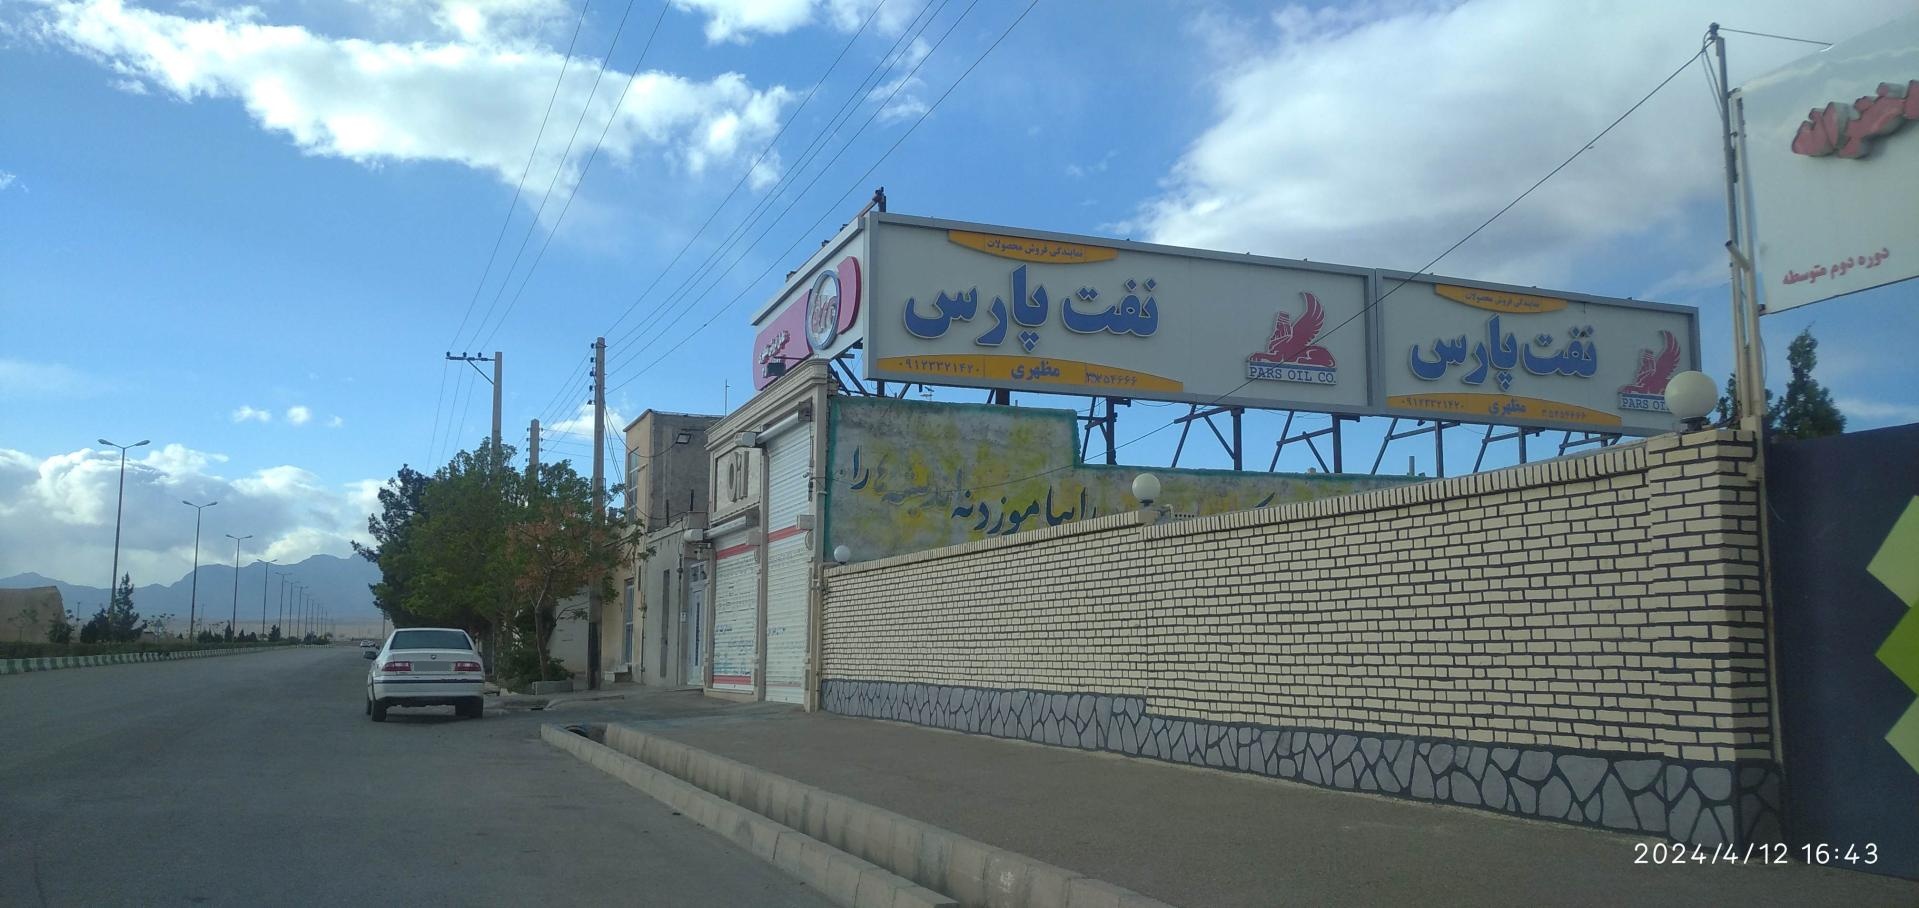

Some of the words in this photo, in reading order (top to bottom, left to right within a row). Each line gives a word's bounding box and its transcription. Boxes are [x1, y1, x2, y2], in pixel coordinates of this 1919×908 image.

[987, 239, 1023, 252] محصولات
[1024, 243, 1049, 255] فروش
[1049, 246, 1083, 257] نمایندگی
[1831, 257, 1855, 280] دوم
[1858, 247, 1890, 269] دوره
[1783, 264, 1827, 284] متوسطه
[904, 264, 1049, 353] پارس
[1062, 277, 1160, 337] نفت
[1410, 313, 1518, 391] پارس
[1522, 325, 1598, 378] نفت
[1010, 359, 1060, 380] مظهری
[1249, 366, 1282, 379] PARS
[1287, 369, 1312, 382] OIL
[1318, 372, 1337, 384] CO.
[1622, 397, 1649, 410] PARS
